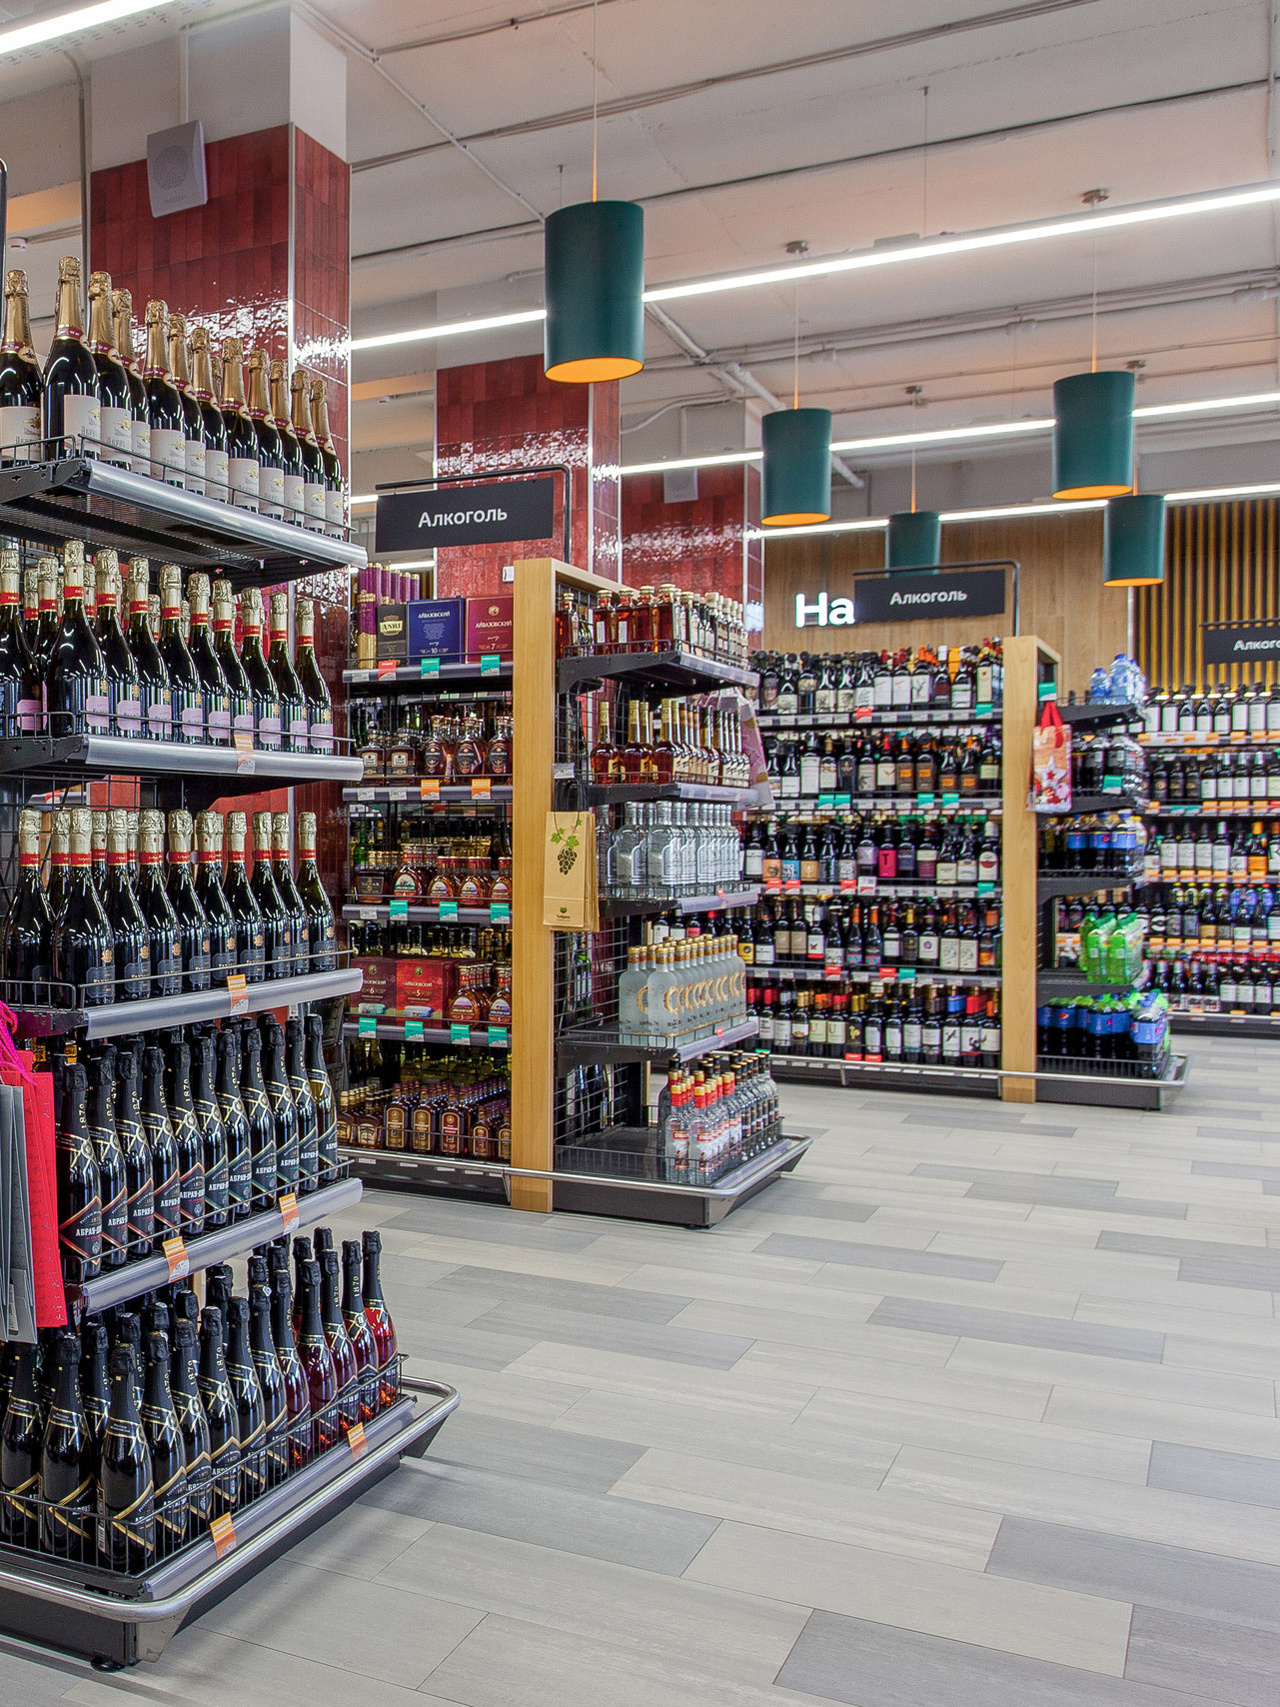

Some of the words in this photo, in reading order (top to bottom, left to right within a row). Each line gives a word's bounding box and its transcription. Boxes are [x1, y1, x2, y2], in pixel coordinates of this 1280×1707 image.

[418, 508, 508, 528] Алкоголь
[890, 590, 968, 605] Алкоголь
[183, 1078, 191, 1103] 1870
[78, 1103, 87, 1129] 1870
[180, 1188, 205, 1200] АБРАУ-Д
[75, 1225, 102, 1237] АБРАУ-Д
[215, 1346, 224, 1372] 1870
[186, 1360, 196, 1386] 1870
